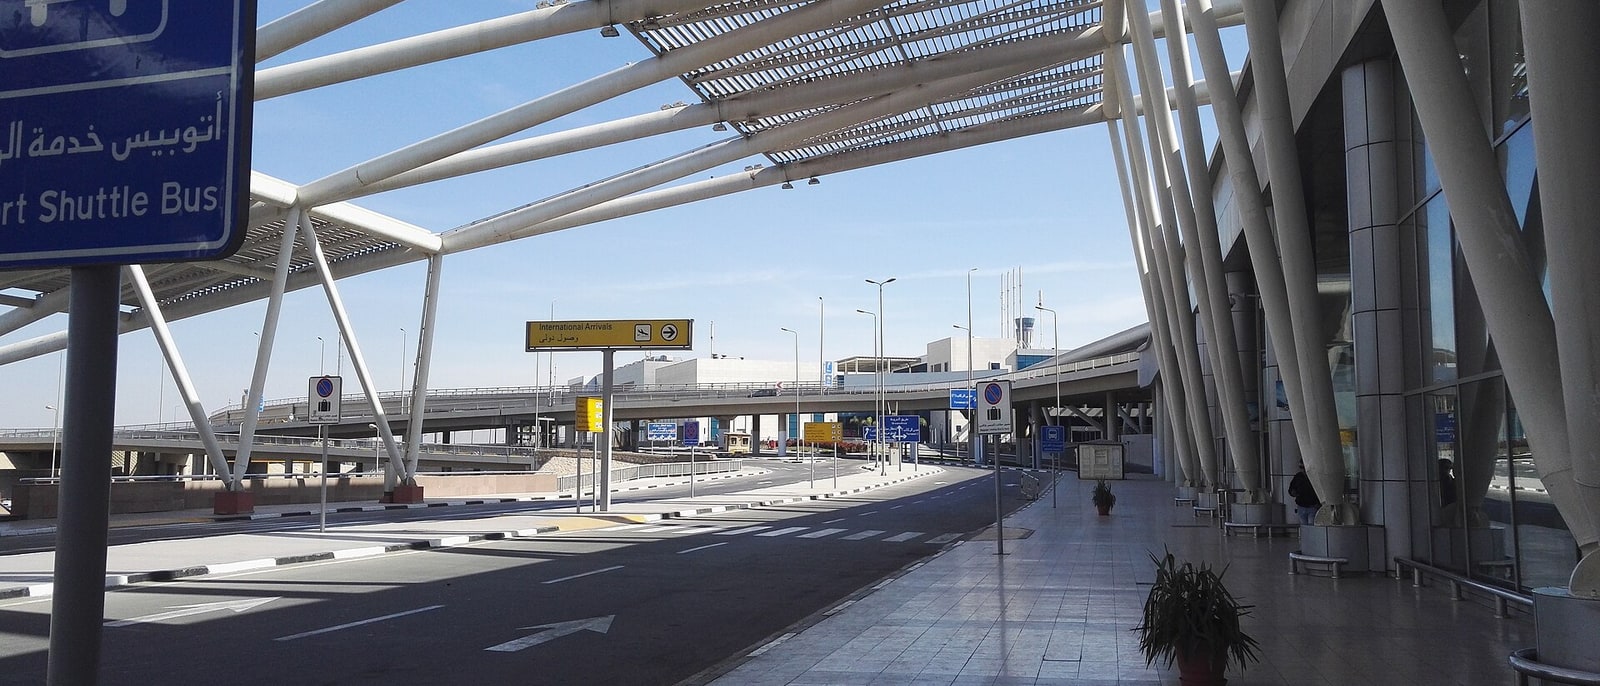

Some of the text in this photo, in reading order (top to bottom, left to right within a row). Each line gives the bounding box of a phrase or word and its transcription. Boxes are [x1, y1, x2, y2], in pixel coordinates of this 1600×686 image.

[28, 124, 104, 157] خدمة
[111, 90, 223, 162] أتوبيس
[38, 185, 149, 223] Shuttle
[161, 181, 218, 215] Bus
[539, 322, 613, 331] International Arrivals
[557, 334, 579, 343] وصول
